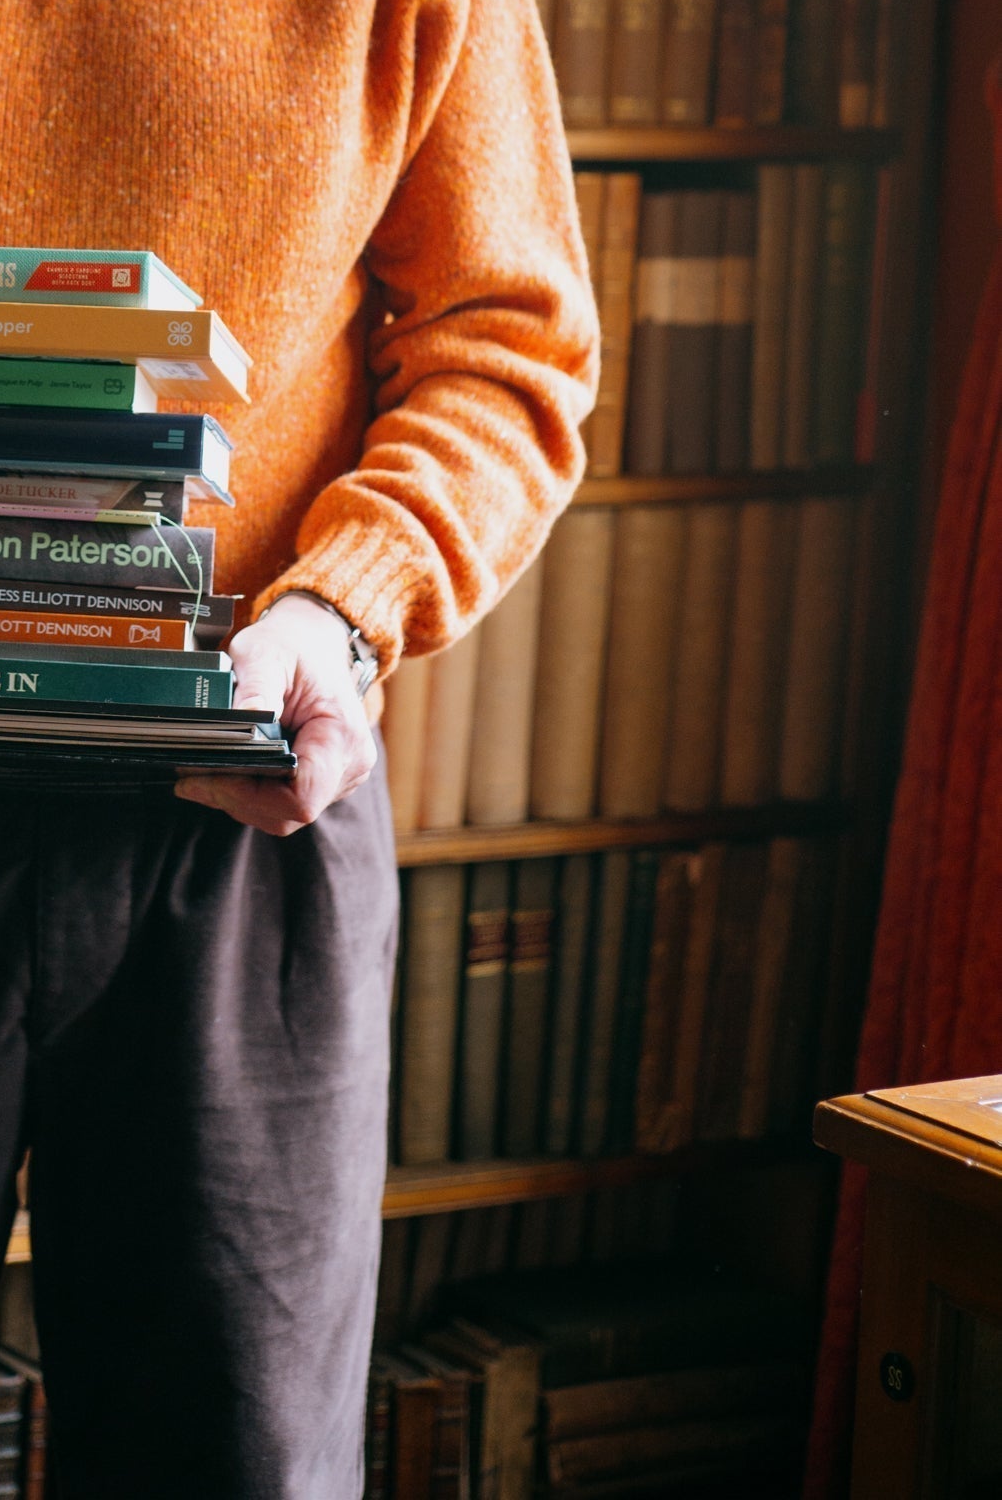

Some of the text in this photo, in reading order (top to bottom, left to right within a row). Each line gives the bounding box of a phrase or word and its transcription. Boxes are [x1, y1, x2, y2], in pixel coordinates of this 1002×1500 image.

[18, 485, 77, 500] TUCKER
[30, 532, 172, 569] Paterson
[22, 592, 88, 608] ELLIOTT
[88, 596, 163, 612] DENNISON
[36, 622, 112, 638] DENNISON
[5, 672, 39, 693] IN
